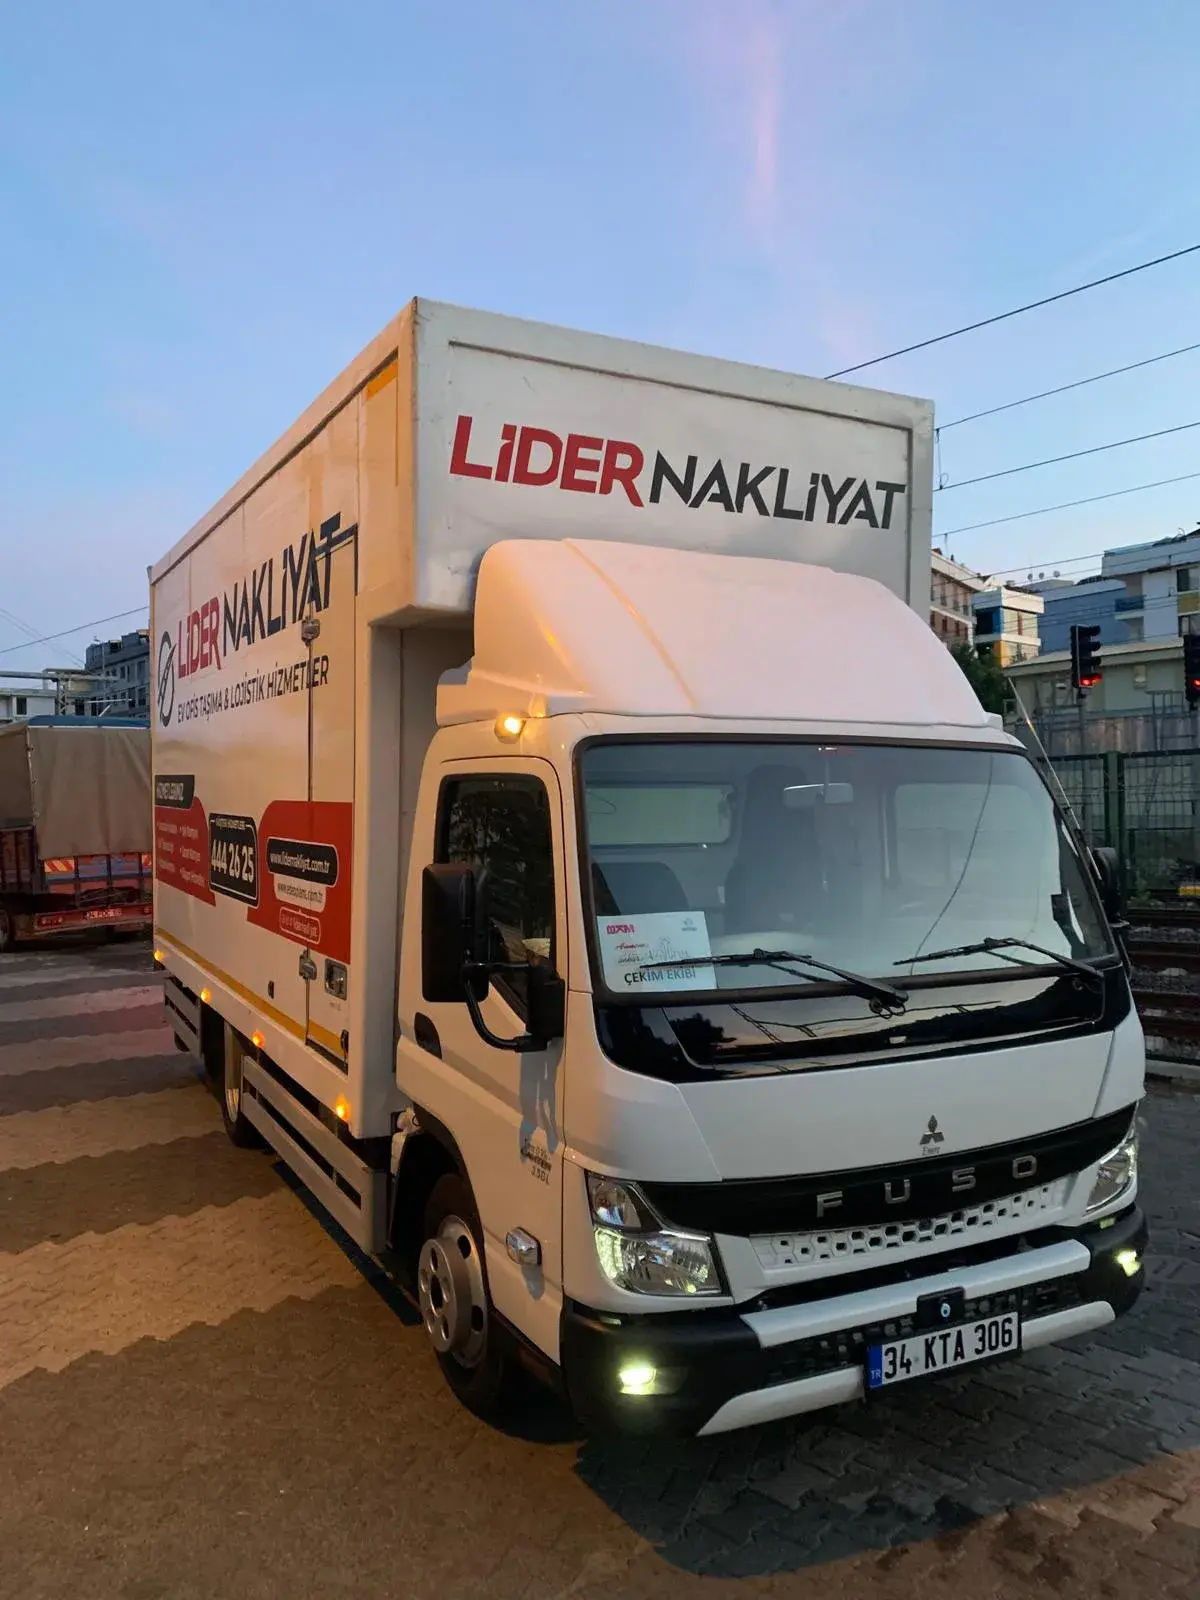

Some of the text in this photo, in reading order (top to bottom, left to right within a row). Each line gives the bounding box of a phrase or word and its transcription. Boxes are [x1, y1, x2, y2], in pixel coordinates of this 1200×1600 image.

[211, 839, 228, 875] 444
[228, 843, 241, 880] 26
[241, 845, 255, 883] 25
[624, 965, 697, 986] ÇEKİM EKİBİ
[816, 1155, 1037, 1218] FUSO
[870, 1316, 1013, 1381] TR 34 KTA 306
